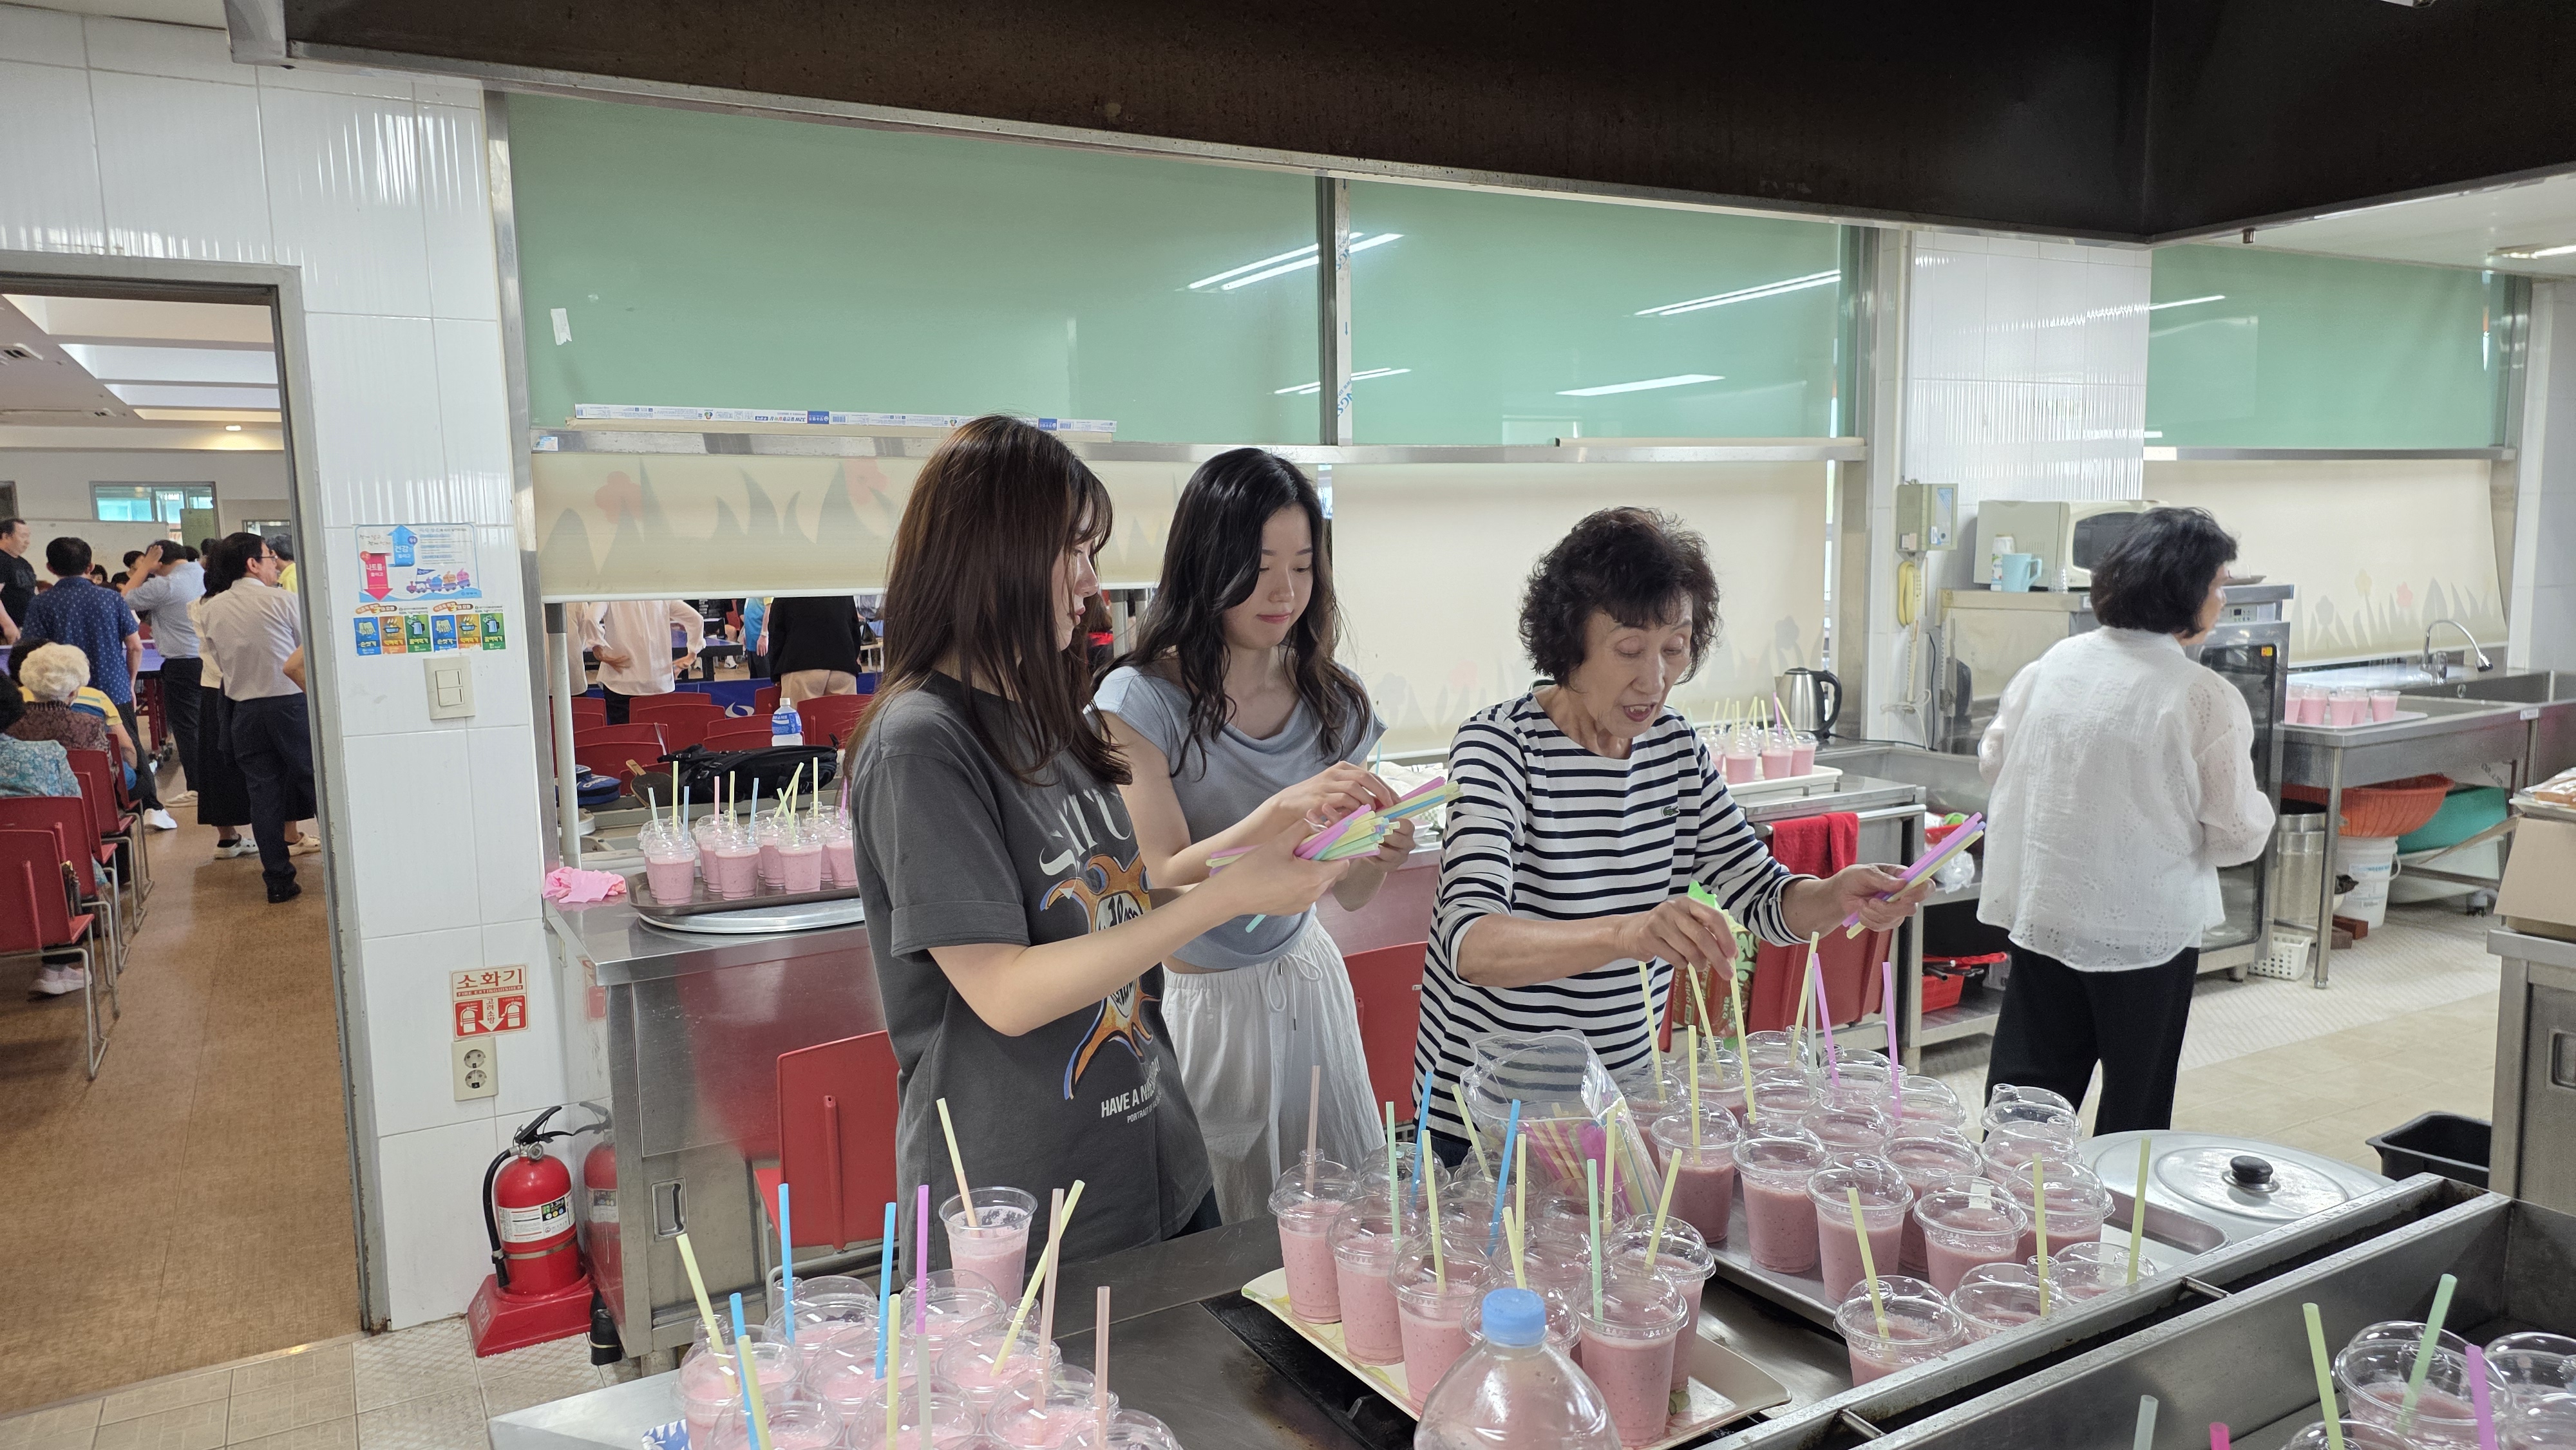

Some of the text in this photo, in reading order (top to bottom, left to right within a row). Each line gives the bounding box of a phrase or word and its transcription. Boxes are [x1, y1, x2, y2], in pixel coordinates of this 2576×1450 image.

[456, 968, 523, 990] 소화기
[474, 986, 522, 995] EXTINGUISHER
[486, 998, 495, 1024] 고려소방
[1101, 1092, 1130, 1118] HAVE
[1132, 1088, 1140, 1107] A
[1127, 1106, 1149, 1124] PORTRAIT
